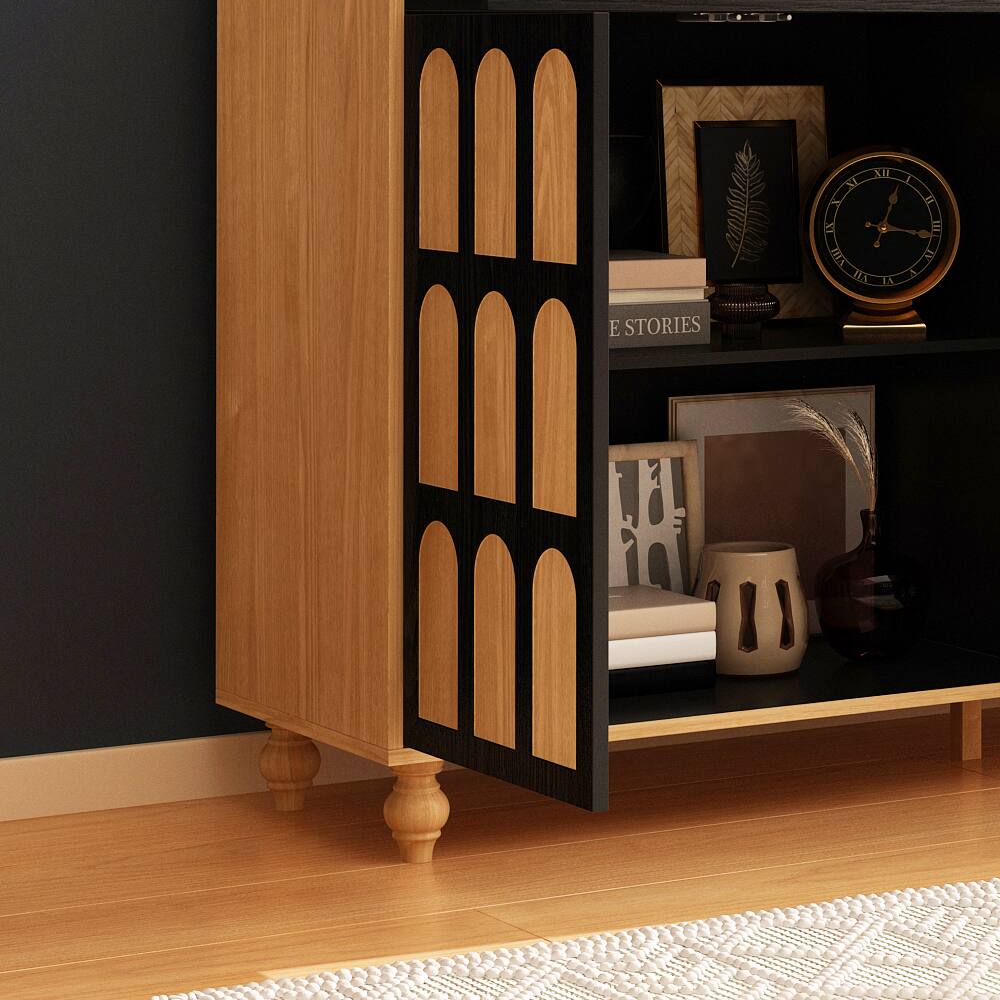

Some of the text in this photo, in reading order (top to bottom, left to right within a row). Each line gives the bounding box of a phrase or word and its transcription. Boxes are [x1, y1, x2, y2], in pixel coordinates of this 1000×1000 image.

[873, 168, 890, 177] XII
[845, 177, 858, 188] XI
[905, 175, 912, 184] I
[831, 199, 840, 208] X
[925, 195, 935, 205] II
[825, 222, 834, 234] IX
[932, 220, 941, 232] III
[831, 248, 845, 267] VIII
[925, 249, 934, 262] IV
[853, 270, 868, 283] VII
[909, 269, 917, 278] V
[882, 277, 895, 285] VI
[625, 315, 701, 337] STORIES
